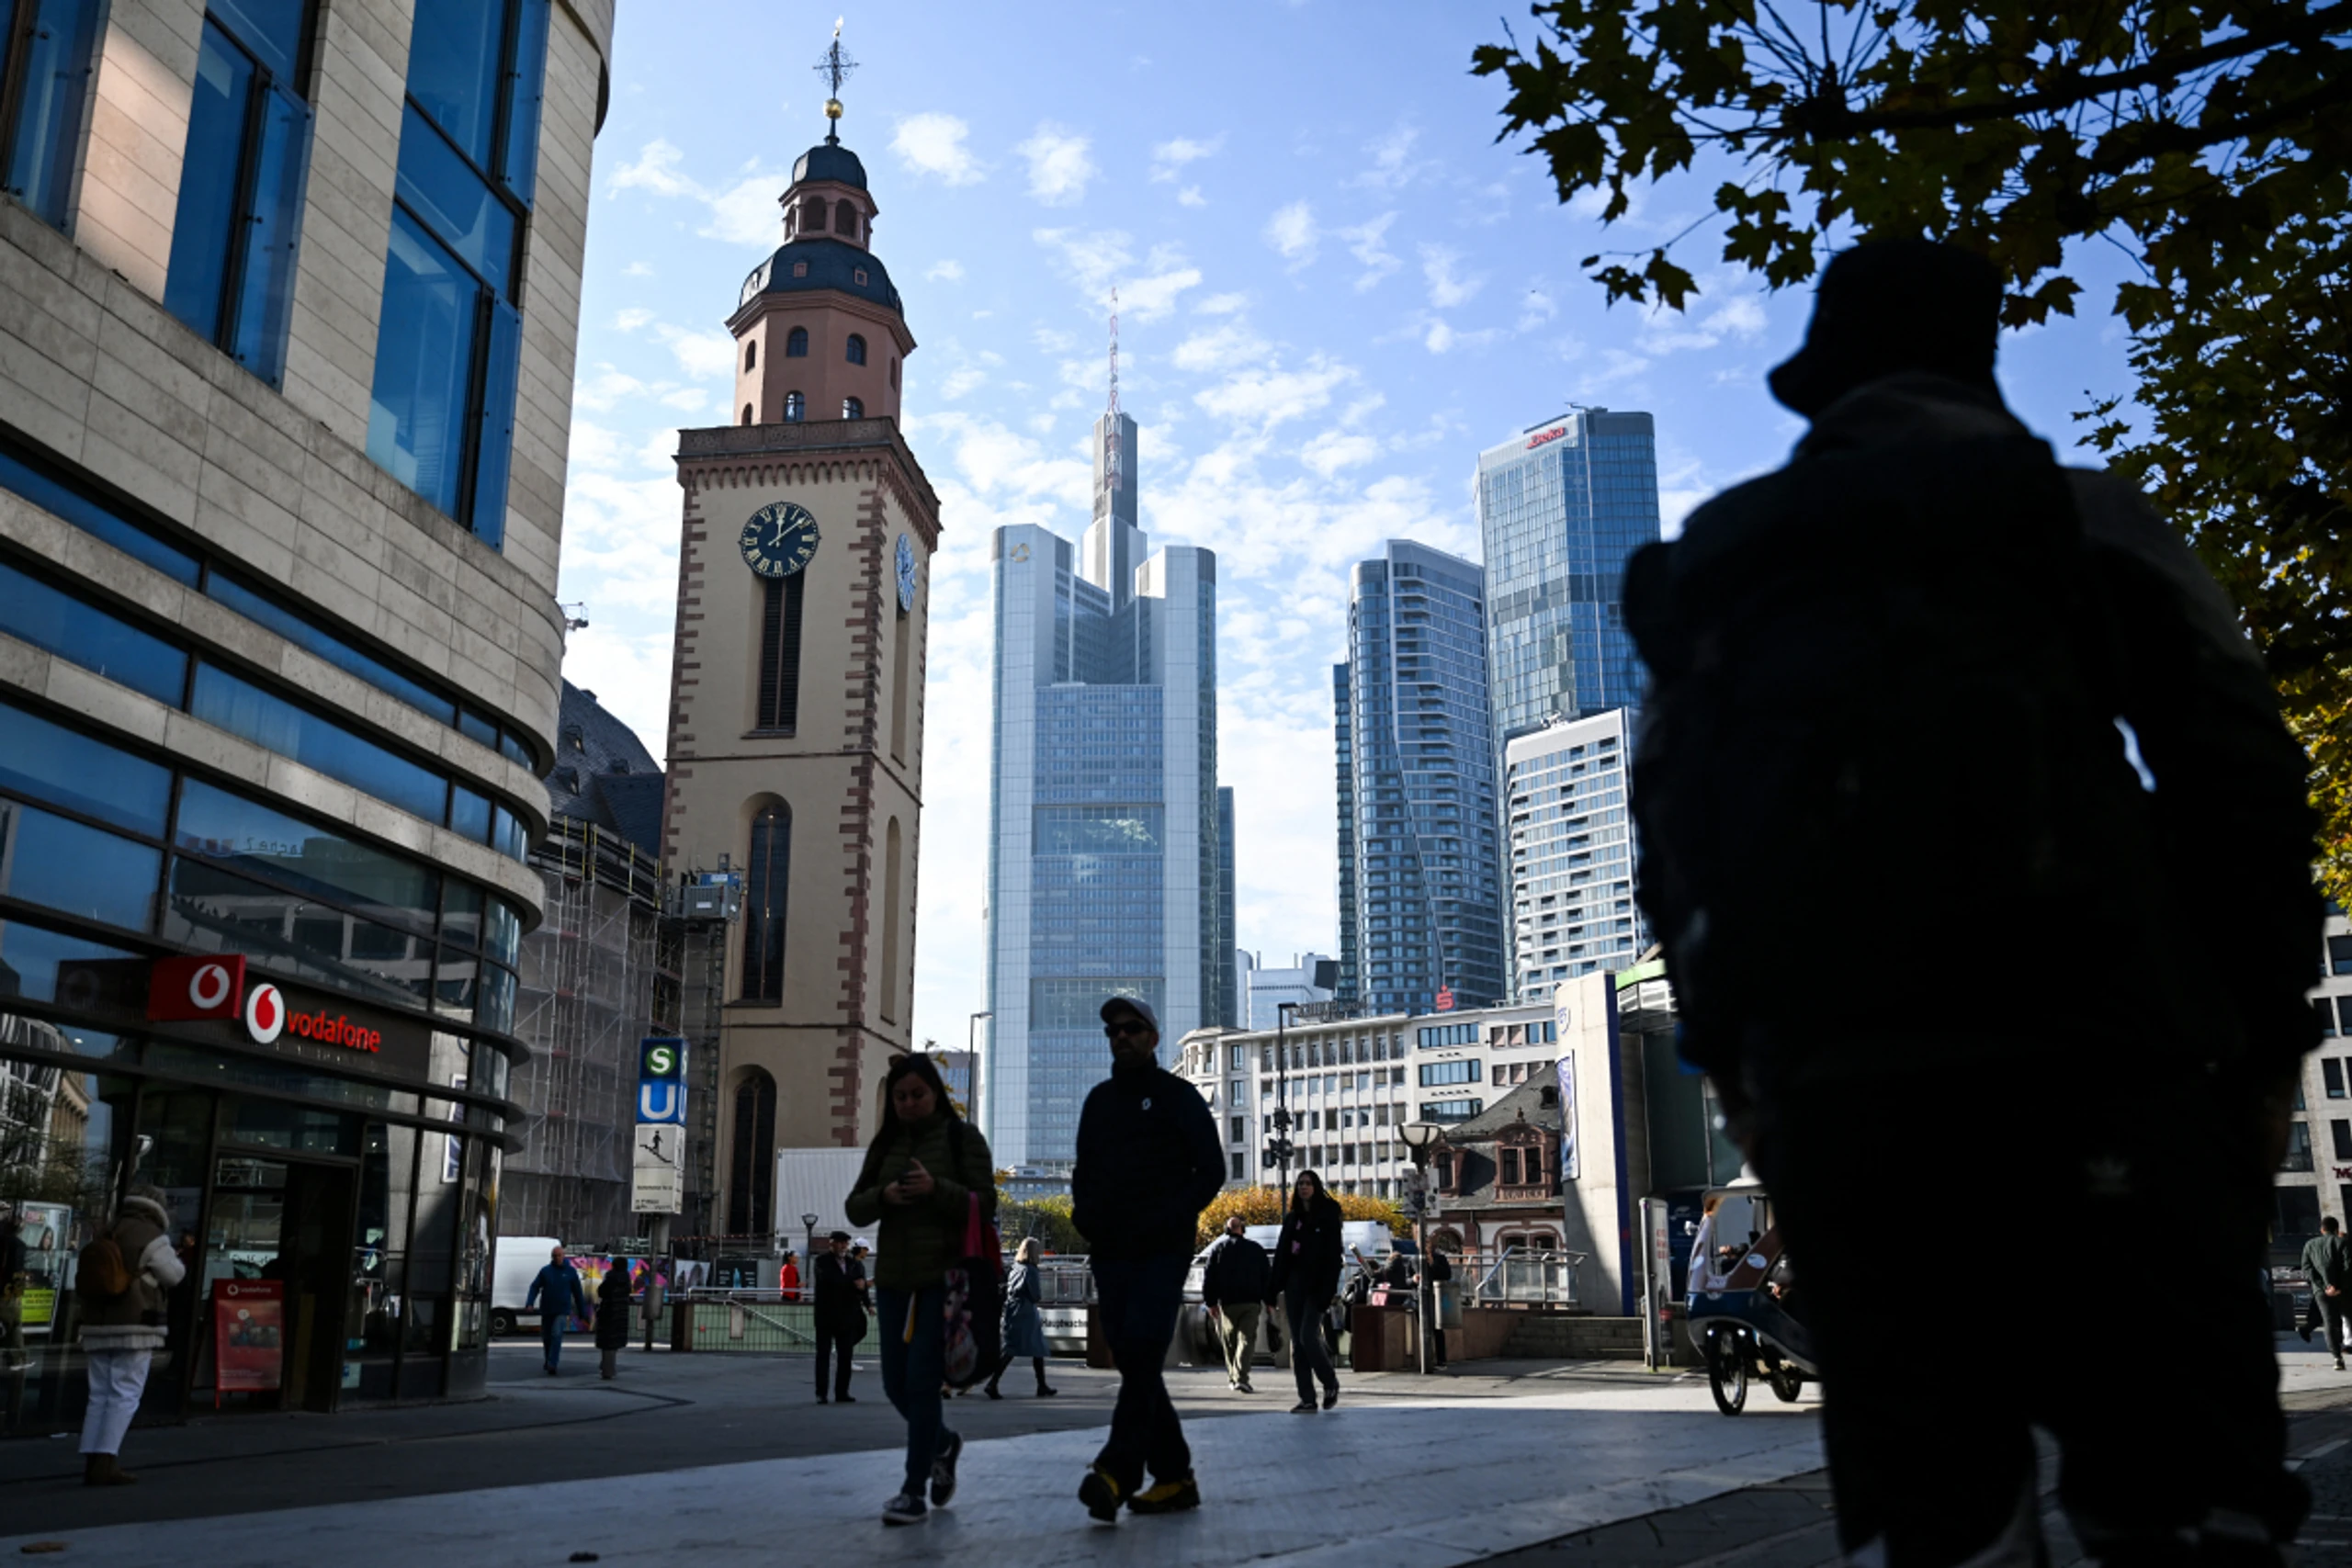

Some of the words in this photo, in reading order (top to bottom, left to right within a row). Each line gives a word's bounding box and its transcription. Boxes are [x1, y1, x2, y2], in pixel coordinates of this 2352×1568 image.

[287, 1010, 381, 1053] vodafone
[650, 1048, 671, 1073] S
[641, 1085, 675, 1120] U
